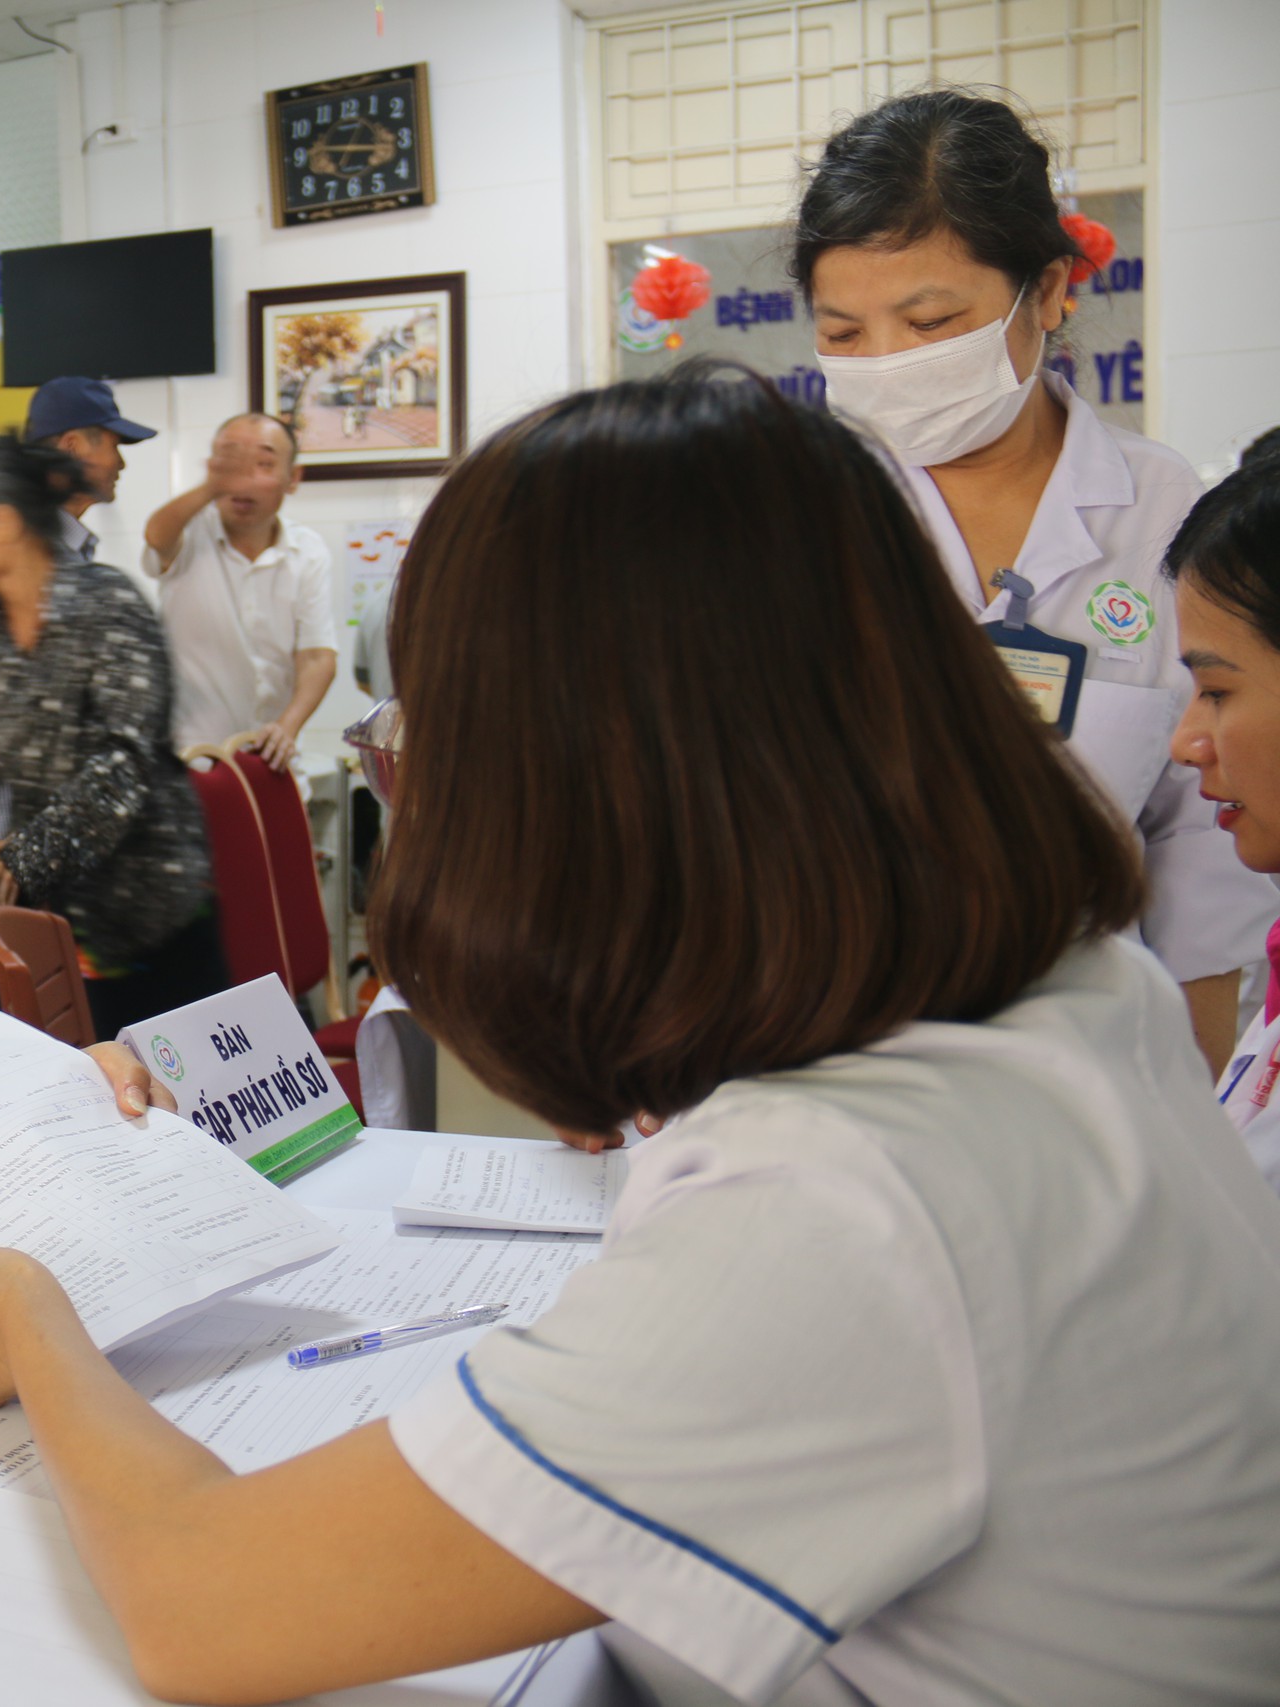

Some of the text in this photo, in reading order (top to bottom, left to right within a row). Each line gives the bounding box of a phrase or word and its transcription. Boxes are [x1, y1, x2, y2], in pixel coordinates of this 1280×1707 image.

[316, 105, 332, 124] 11
[341, 98, 360, 118] 12
[369, 95, 378, 115] 1
[389, 97, 404, 118] 2
[292, 119, 311, 139] 10
[397, 127, 412, 149] 3
[293, 147, 307, 167] 9
[395, 158, 409, 179] 4
[301, 175, 316, 197] 8
[325, 180, 338, 201] 7
[346, 176, 362, 197] 6
[371, 173, 385, 194] 5
[716, 286, 794, 332] BỆNH
[1094, 340, 1144, 404] YÊ
[210, 1022, 253, 1061] BÀN
[191, 1089, 238, 1146] CẤP
[227, 1074, 284, 1134] PHÁT
[270, 1055, 307, 1112] HỒ
[295, 1052, 329, 1100] SƠ
